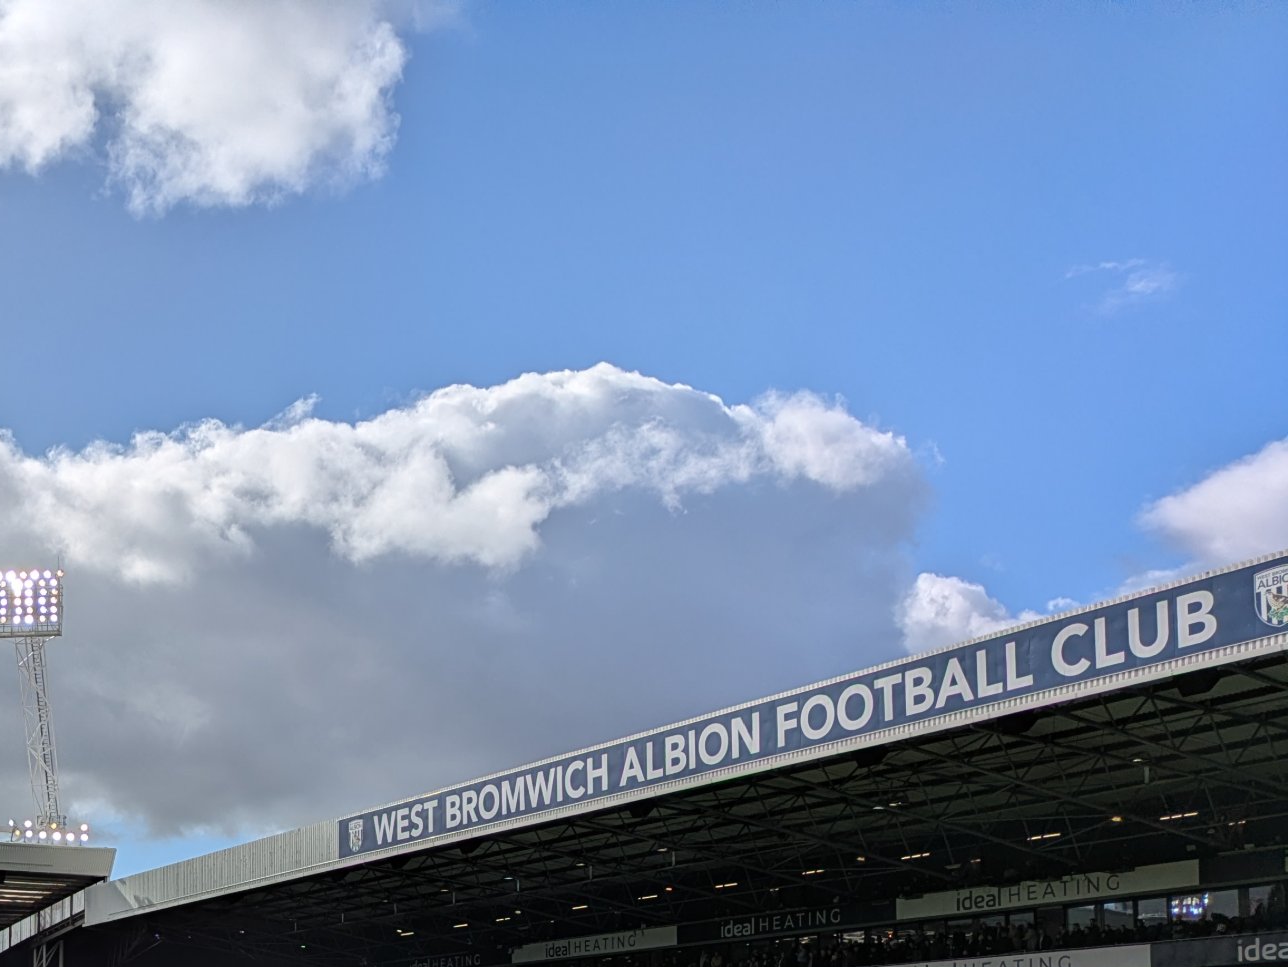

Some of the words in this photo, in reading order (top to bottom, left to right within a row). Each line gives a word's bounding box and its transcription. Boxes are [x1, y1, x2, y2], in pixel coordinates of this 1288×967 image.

[373, 799, 439, 845] WEST
[445, 753, 608, 828] BROMWICH
[619, 712, 760, 787] ALBION
[777, 643, 1034, 748] FOOTBALL
[1051, 590, 1218, 677] CLUB
[956, 886, 1001, 912] ideal
[1009, 874, 1120, 903] HEATING
[720, 917, 755, 938] ideal
[759, 908, 841, 932] HEATING
[545, 941, 571, 958] ideal
[574, 934, 635, 952] HEATING
